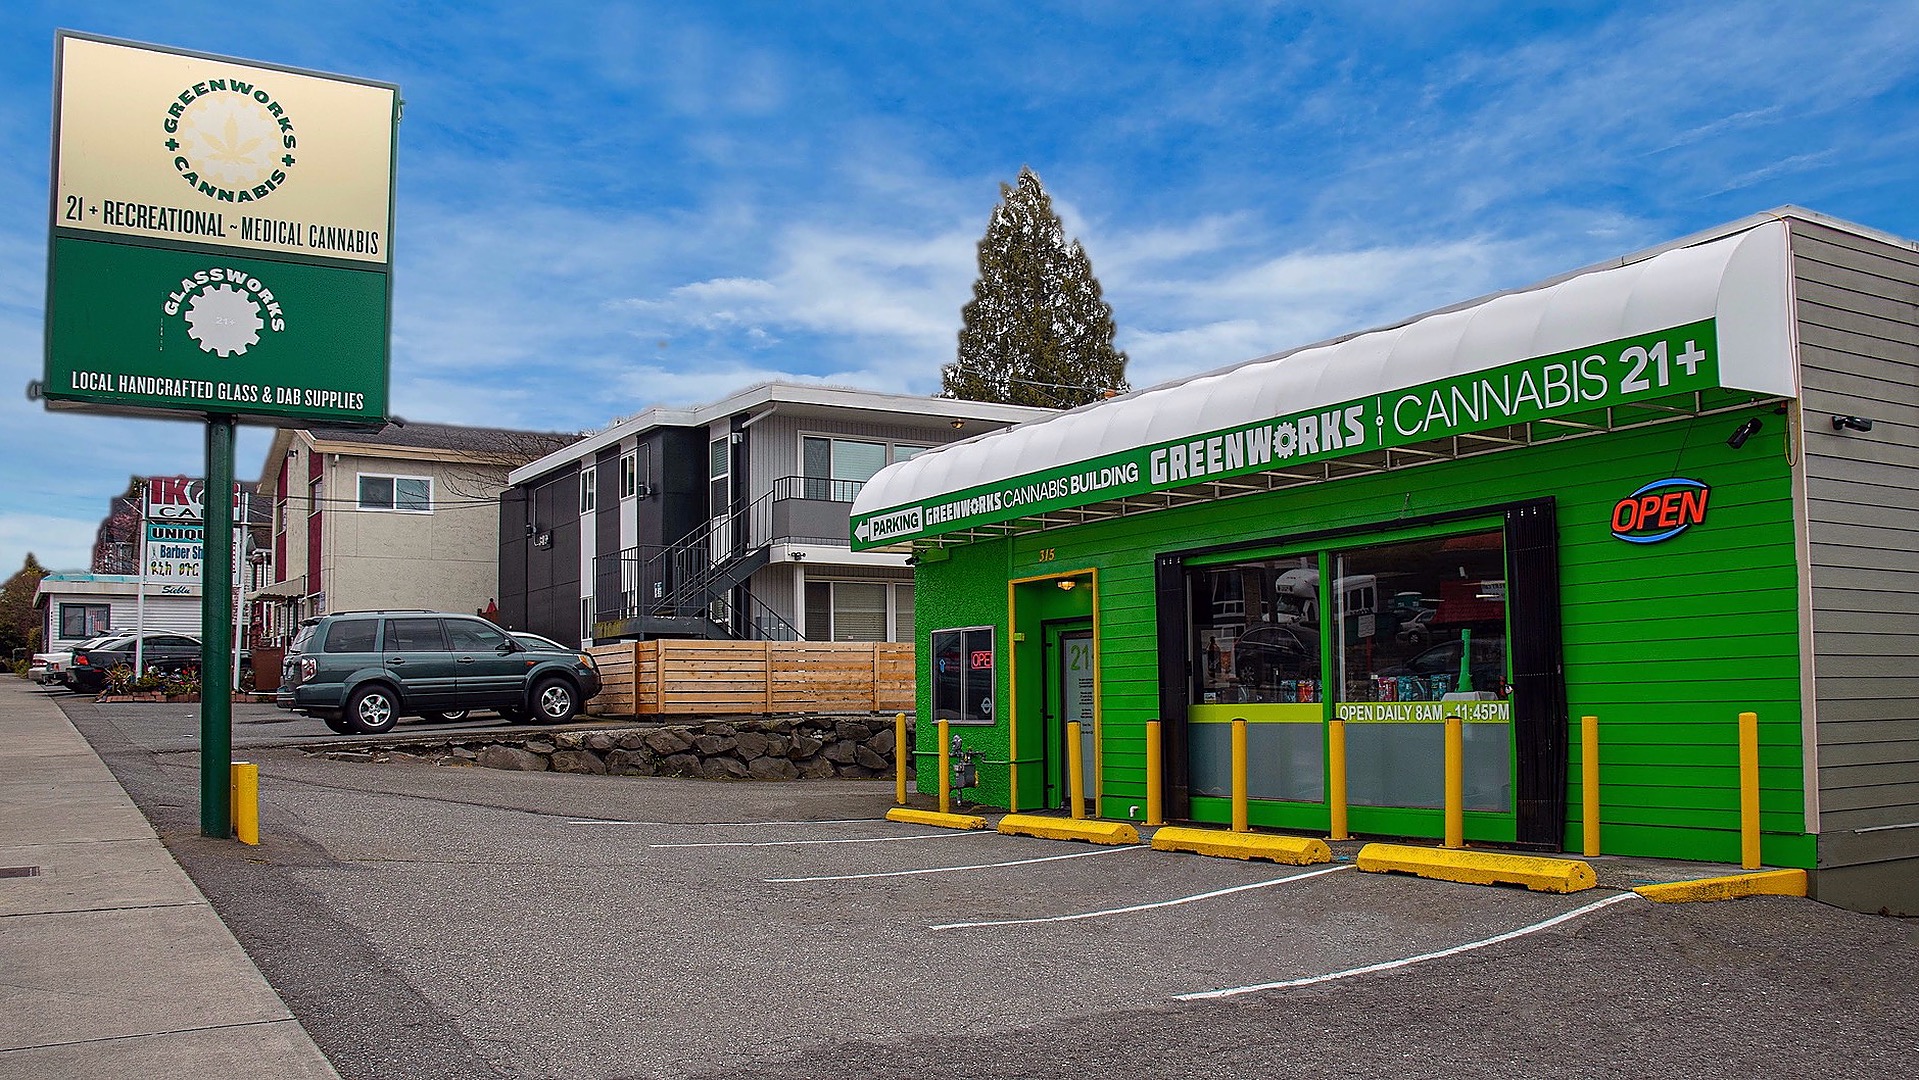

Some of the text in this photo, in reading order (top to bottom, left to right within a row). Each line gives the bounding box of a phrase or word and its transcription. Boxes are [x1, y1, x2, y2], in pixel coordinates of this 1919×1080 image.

[164, 78, 296, 149] GREENWORKS
[174, 155, 286, 203] CANNABIS
[103, 200, 225, 238] RECREATIONAL
[241, 217, 303, 247] MEDICAL
[309, 225, 379, 255] CANNABIS
[164, 268, 285, 332] GLASSWORKS
[72, 371, 364, 410] LOCAL HANDCRAFTED GLASS & DAB SUPPLIES
[1150, 340, 1706, 486] GREENWORKS CANNABIS 21+
[159, 507, 203, 518] CA
[873, 462, 1139, 537] PARKING GREENWORKS CANNABIS BUILDING
[1611, 489, 1708, 532] OPEN
[160, 545, 190, 560] Barber
[1039, 548, 1055, 563] 315
[973, 653, 992, 667] OPE
[1339, 705, 1373, 721] OPEN
[1377, 705, 1413, 721] DAILY
[1416, 704, 1442, 720] 8AM
[1455, 703, 1509, 720] 11:45PM
